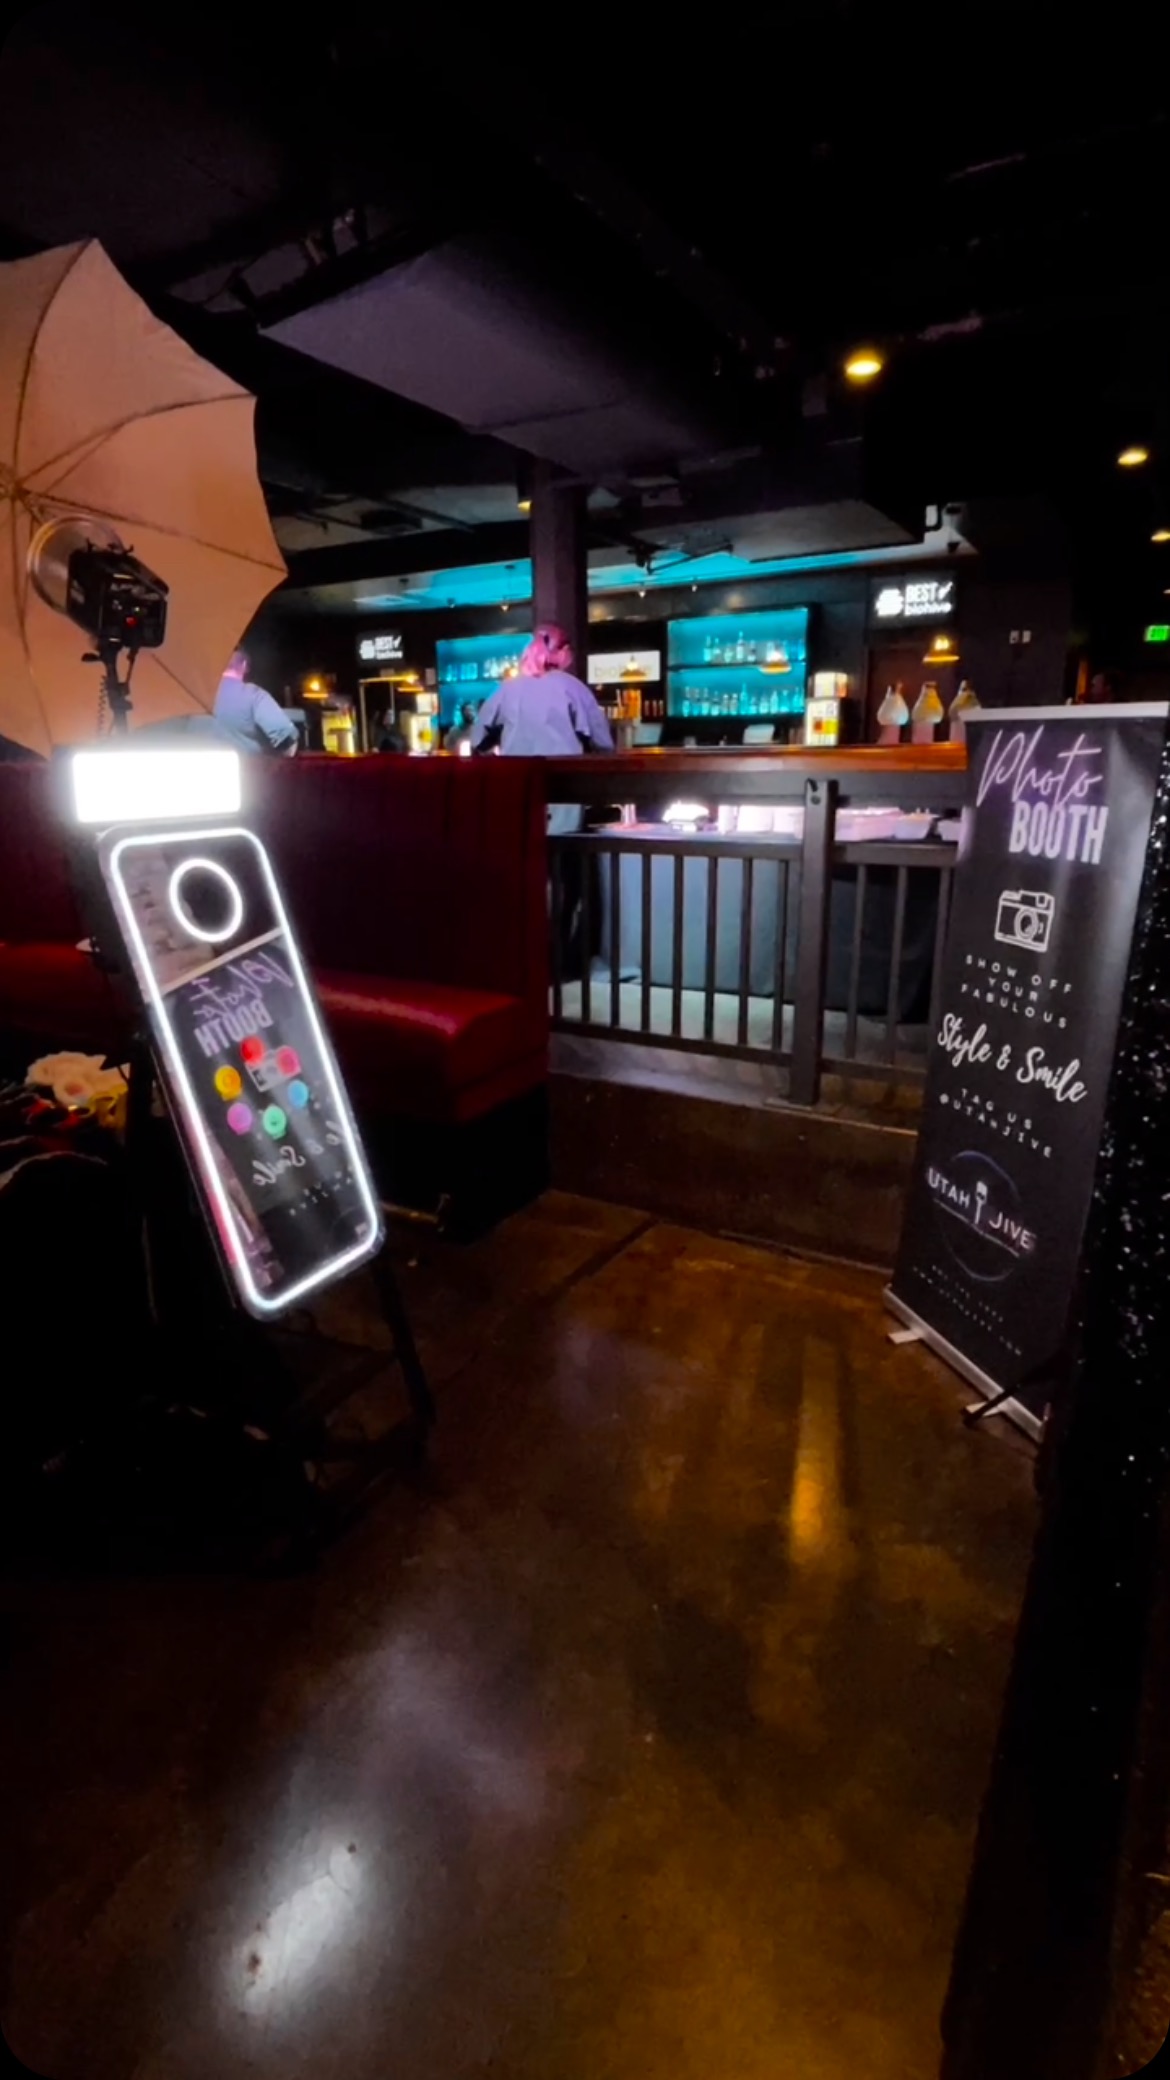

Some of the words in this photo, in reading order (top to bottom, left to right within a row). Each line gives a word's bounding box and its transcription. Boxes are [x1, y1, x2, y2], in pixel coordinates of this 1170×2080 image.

[905, 582, 938, 602] BEST
[976, 724, 1103, 808] Photo
[1009, 800, 1109, 865] BOOTH
[966, 954, 1018, 978] SHOW
[1031, 974, 1072, 994] OFF
[988, 976, 1038, 1002] YOUR
[960, 983, 1067, 1029] FABULOUS
[937, 1013, 992, 1067] Style
[996, 1044, 1012, 1070] &
[1016, 1046, 1088, 1102] Smile
[961, 1088, 994, 1112] TAG
[1007, 1112, 1032, 1130] US
[927, 1167, 970, 1209] UTAH
[988, 1211, 1037, 1250] JIVE
